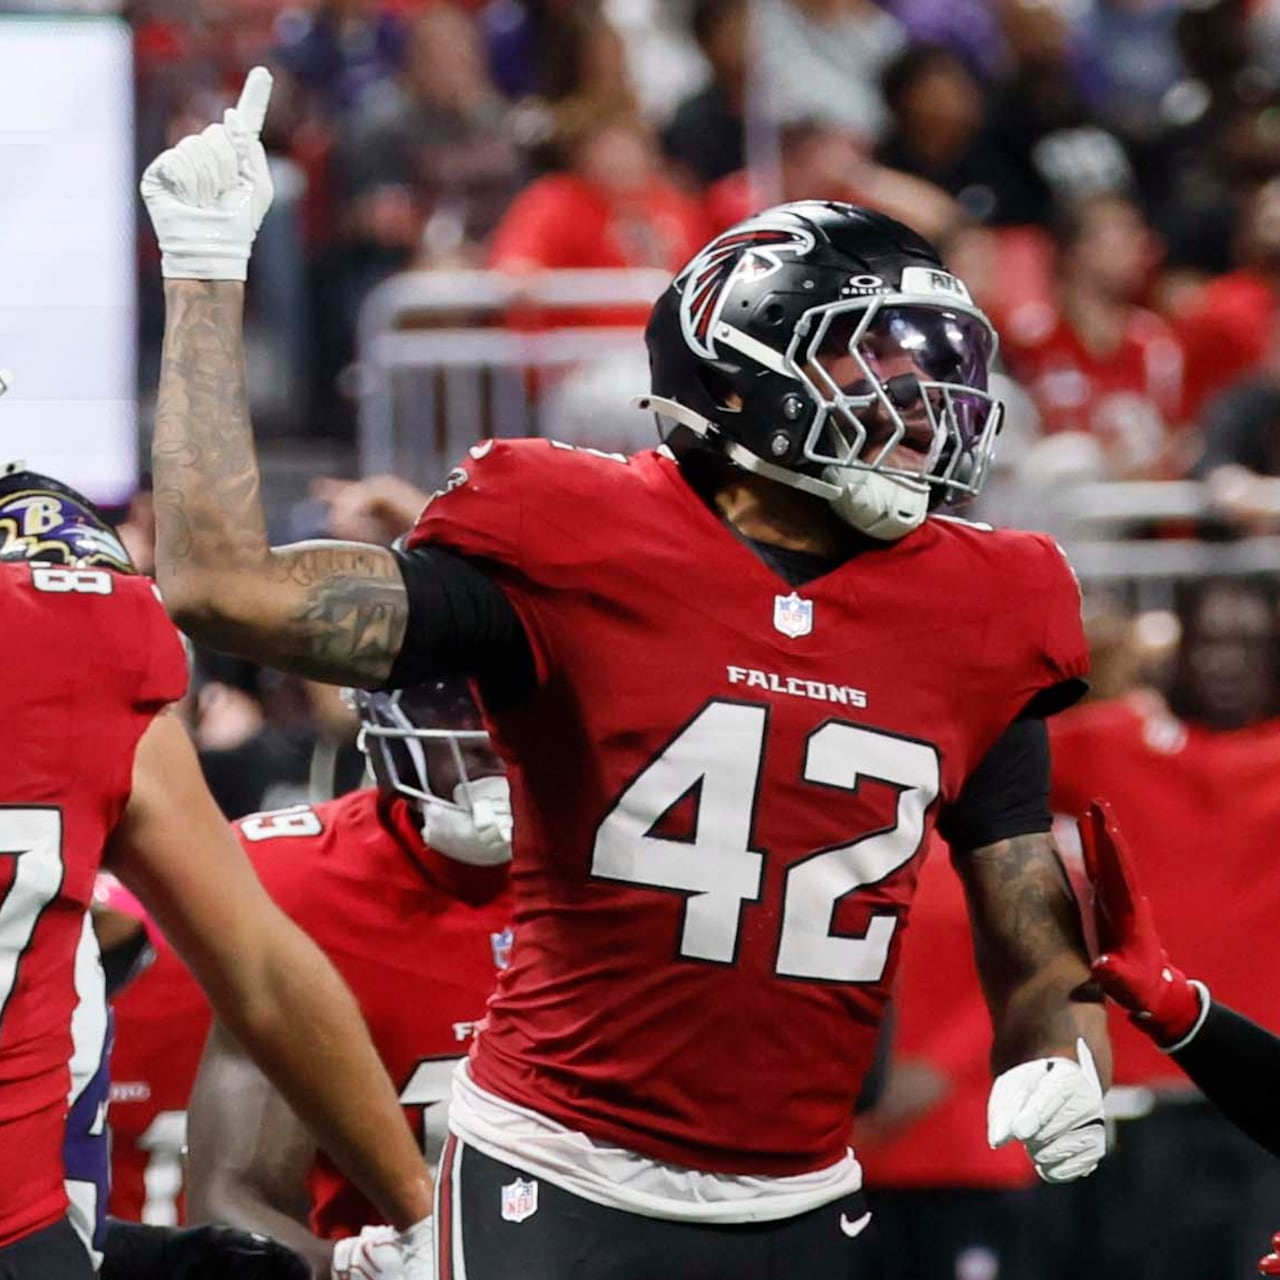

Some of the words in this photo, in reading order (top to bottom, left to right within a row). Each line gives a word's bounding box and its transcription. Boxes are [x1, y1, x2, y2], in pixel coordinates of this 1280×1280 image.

[20, 496, 64, 536] B
[726, 665, 867, 708] FALCONS
[590, 700, 940, 983] 42
